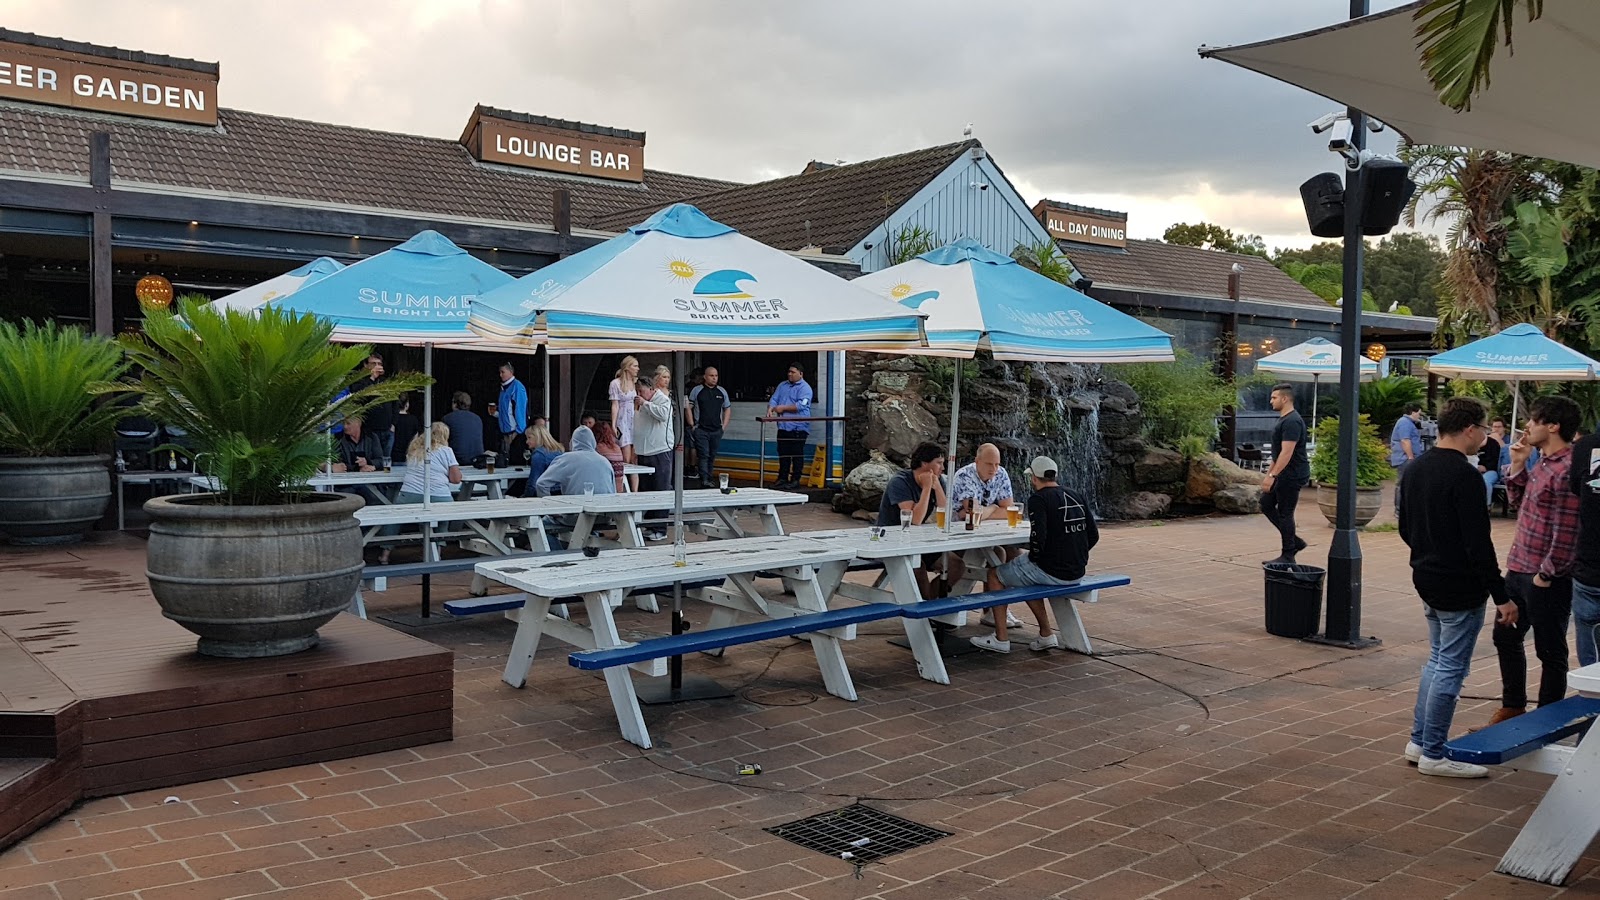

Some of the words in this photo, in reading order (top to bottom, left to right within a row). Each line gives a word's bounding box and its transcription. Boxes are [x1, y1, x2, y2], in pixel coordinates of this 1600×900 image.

[73, 74, 205, 111] GARDEN
[496, 134, 581, 165] LOUNGE
[590, 149, 630, 171] BAR
[1048, 218, 1066, 233] ALL
[1068, 222, 1089, 236] DAY
[1091, 225, 1124, 241] DINING
[358, 287, 477, 309] SUMME
[673, 298, 789, 313] SUMMER
[372, 306, 430, 317] BRIGHT
[1475, 351, 1549, 362] SUMMER
